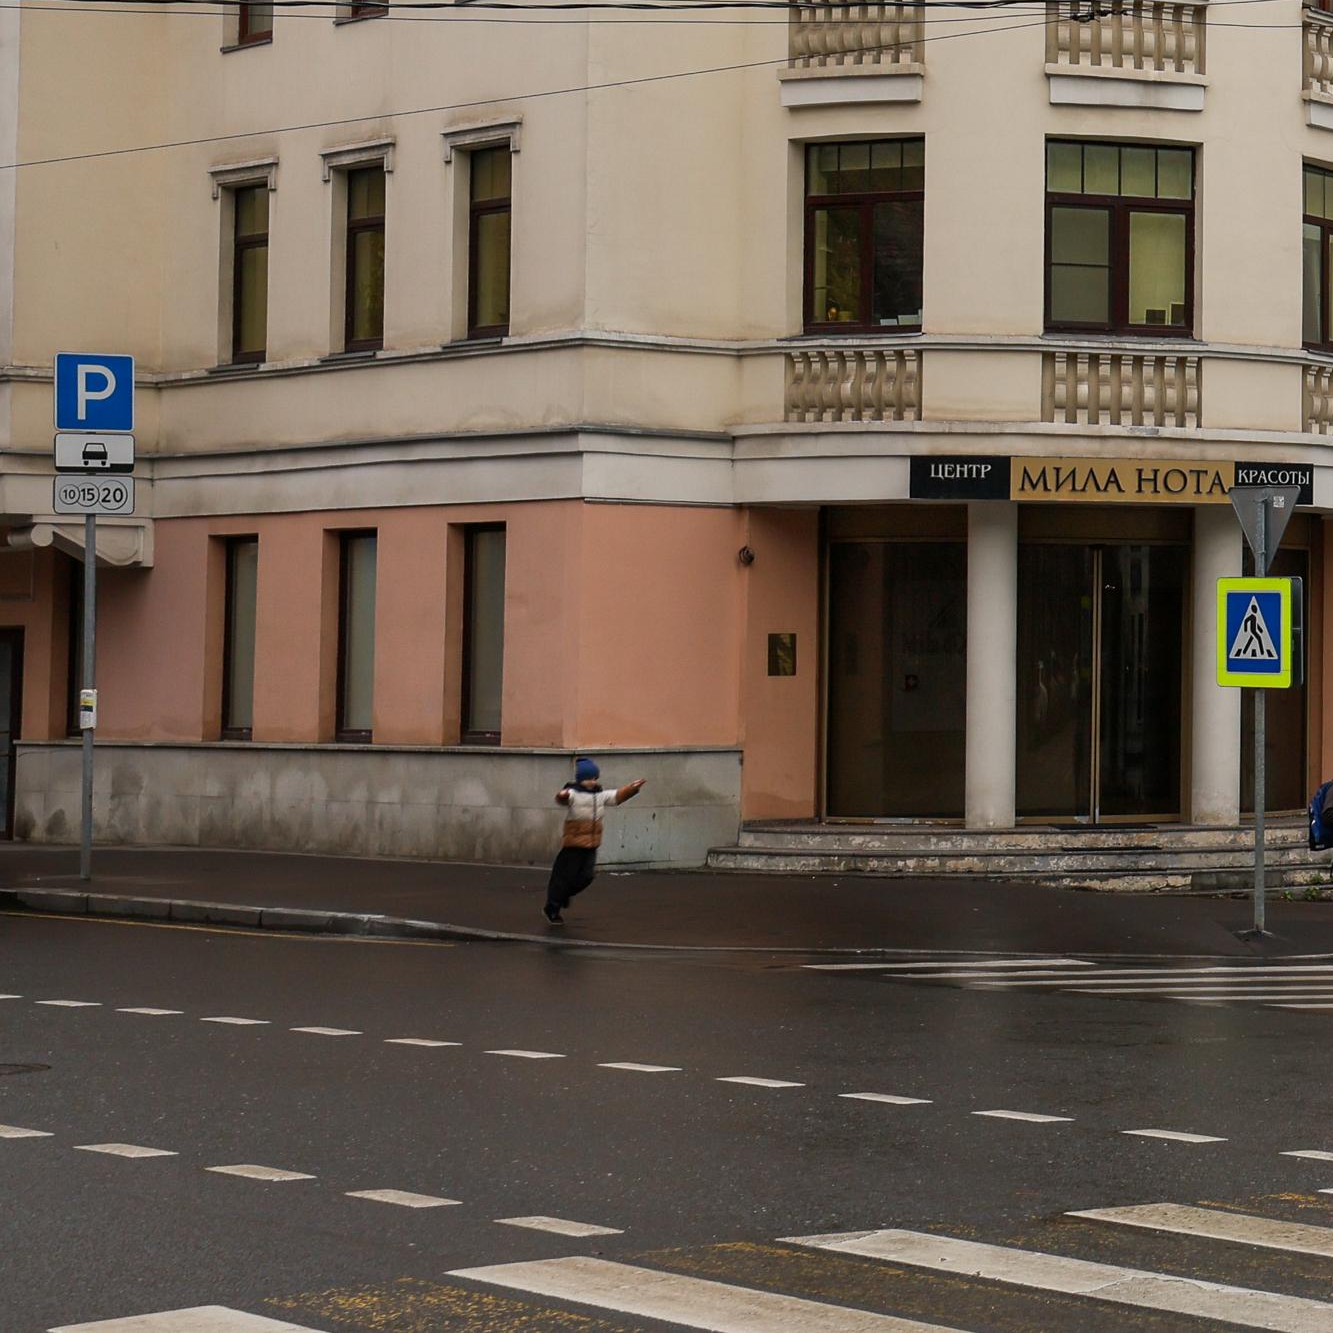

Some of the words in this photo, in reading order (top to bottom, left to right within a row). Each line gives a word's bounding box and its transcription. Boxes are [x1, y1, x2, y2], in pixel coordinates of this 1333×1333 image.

[77, 364, 117, 420] P
[930, 464, 992, 480] ЦЕНТР
[1019, 465, 1126, 494] МИЛА
[1135, 468, 1230, 495] НОТА
[1238, 469, 1310, 485] КРАСОТЫ
[63, 489, 76, 500] 10
[80, 488, 95, 502] 15
[101, 487, 124, 503] 20
